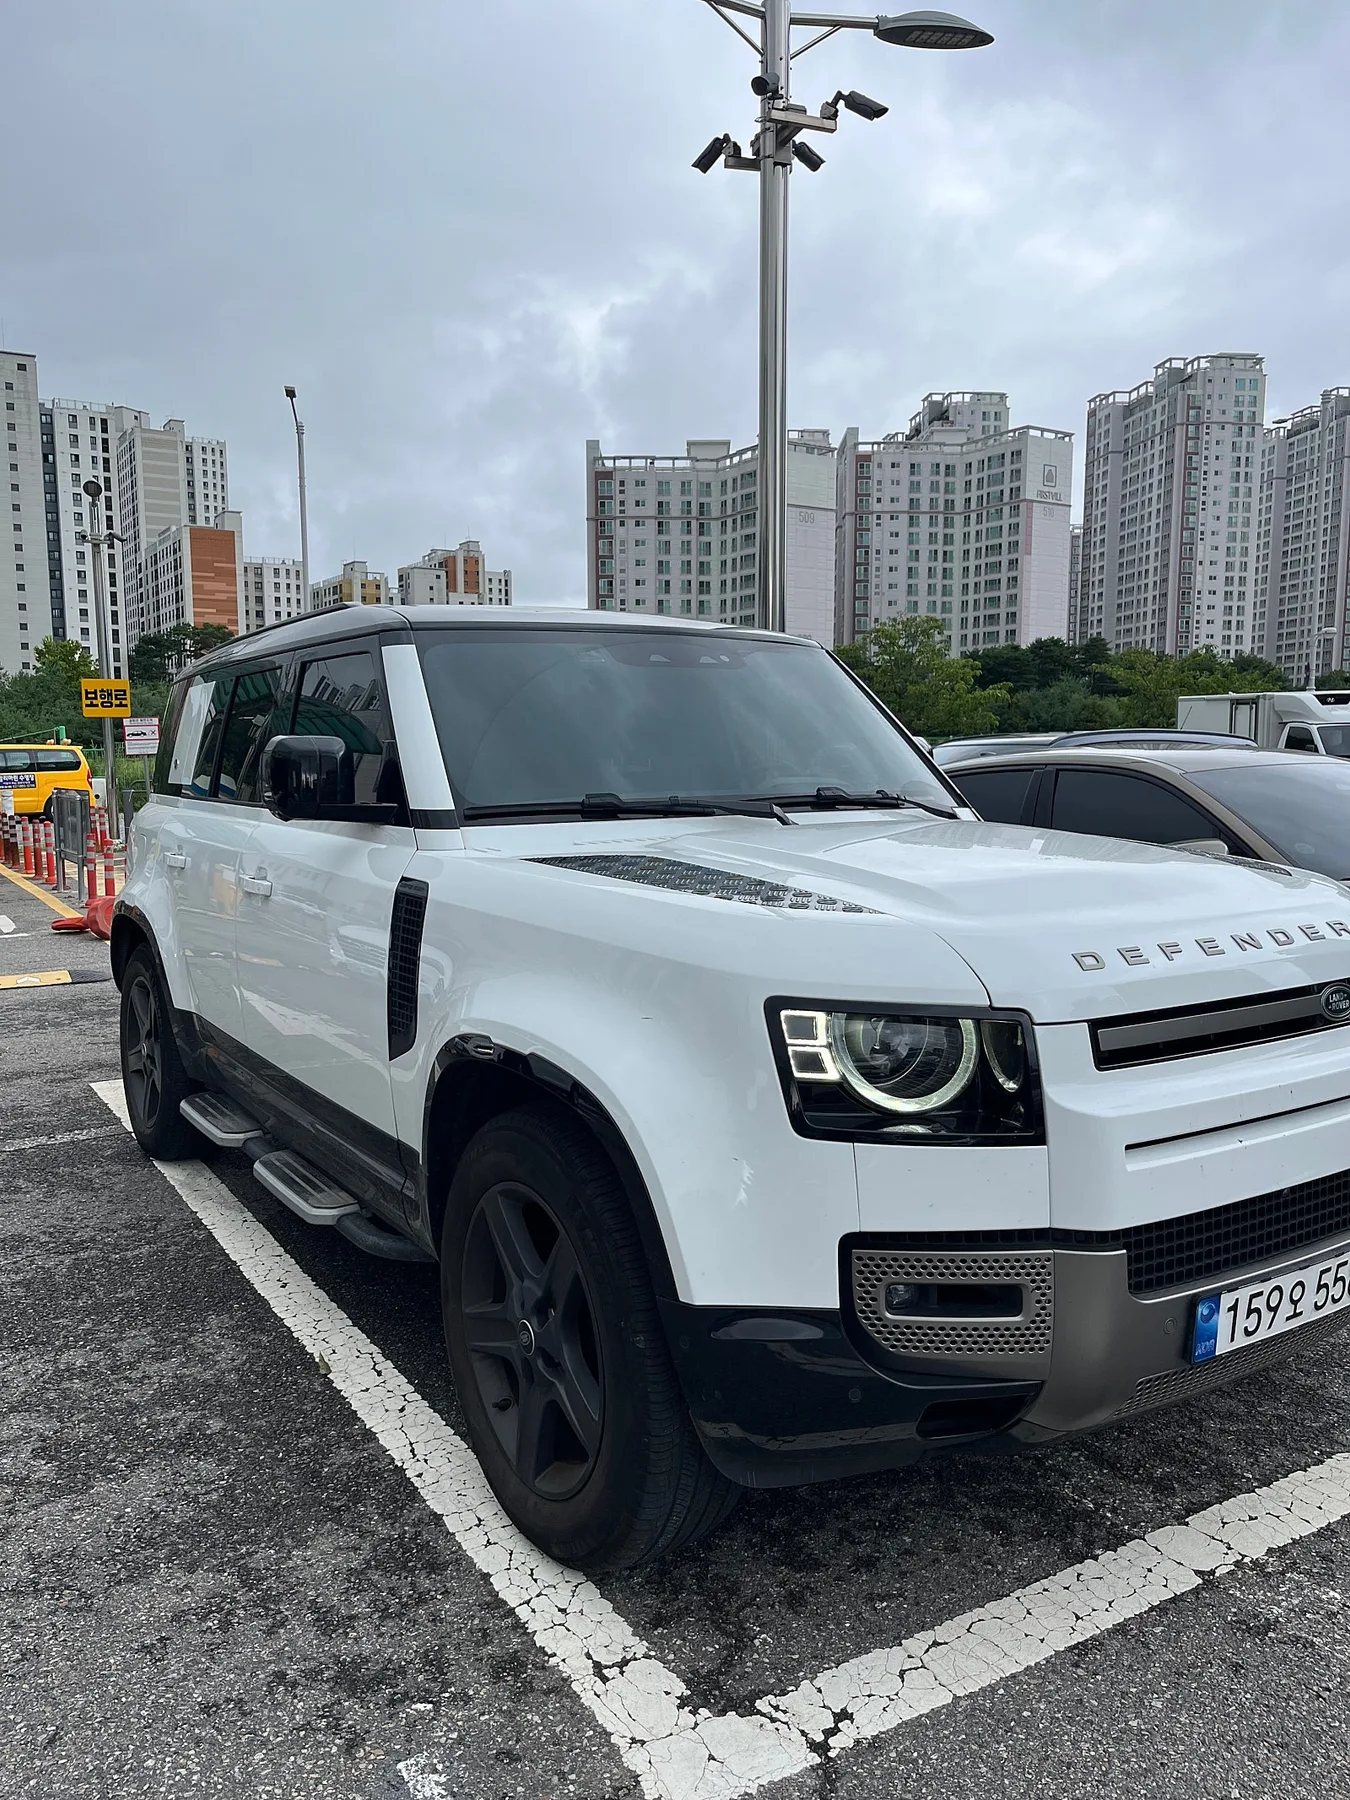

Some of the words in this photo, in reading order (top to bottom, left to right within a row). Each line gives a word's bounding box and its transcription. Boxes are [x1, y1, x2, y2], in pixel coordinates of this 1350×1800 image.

[798, 510, 815, 524] 509
[84, 688, 129, 709] 보행로
[1071, 919, 1350, 971] DEFENDER
[1329, 992, 1344, 1003] LAND
[1331, 999, 1350, 1011] ROVER
[1226, 1279, 1306, 1344] 159오
[1313, 1259, 1350, 1312] 55
